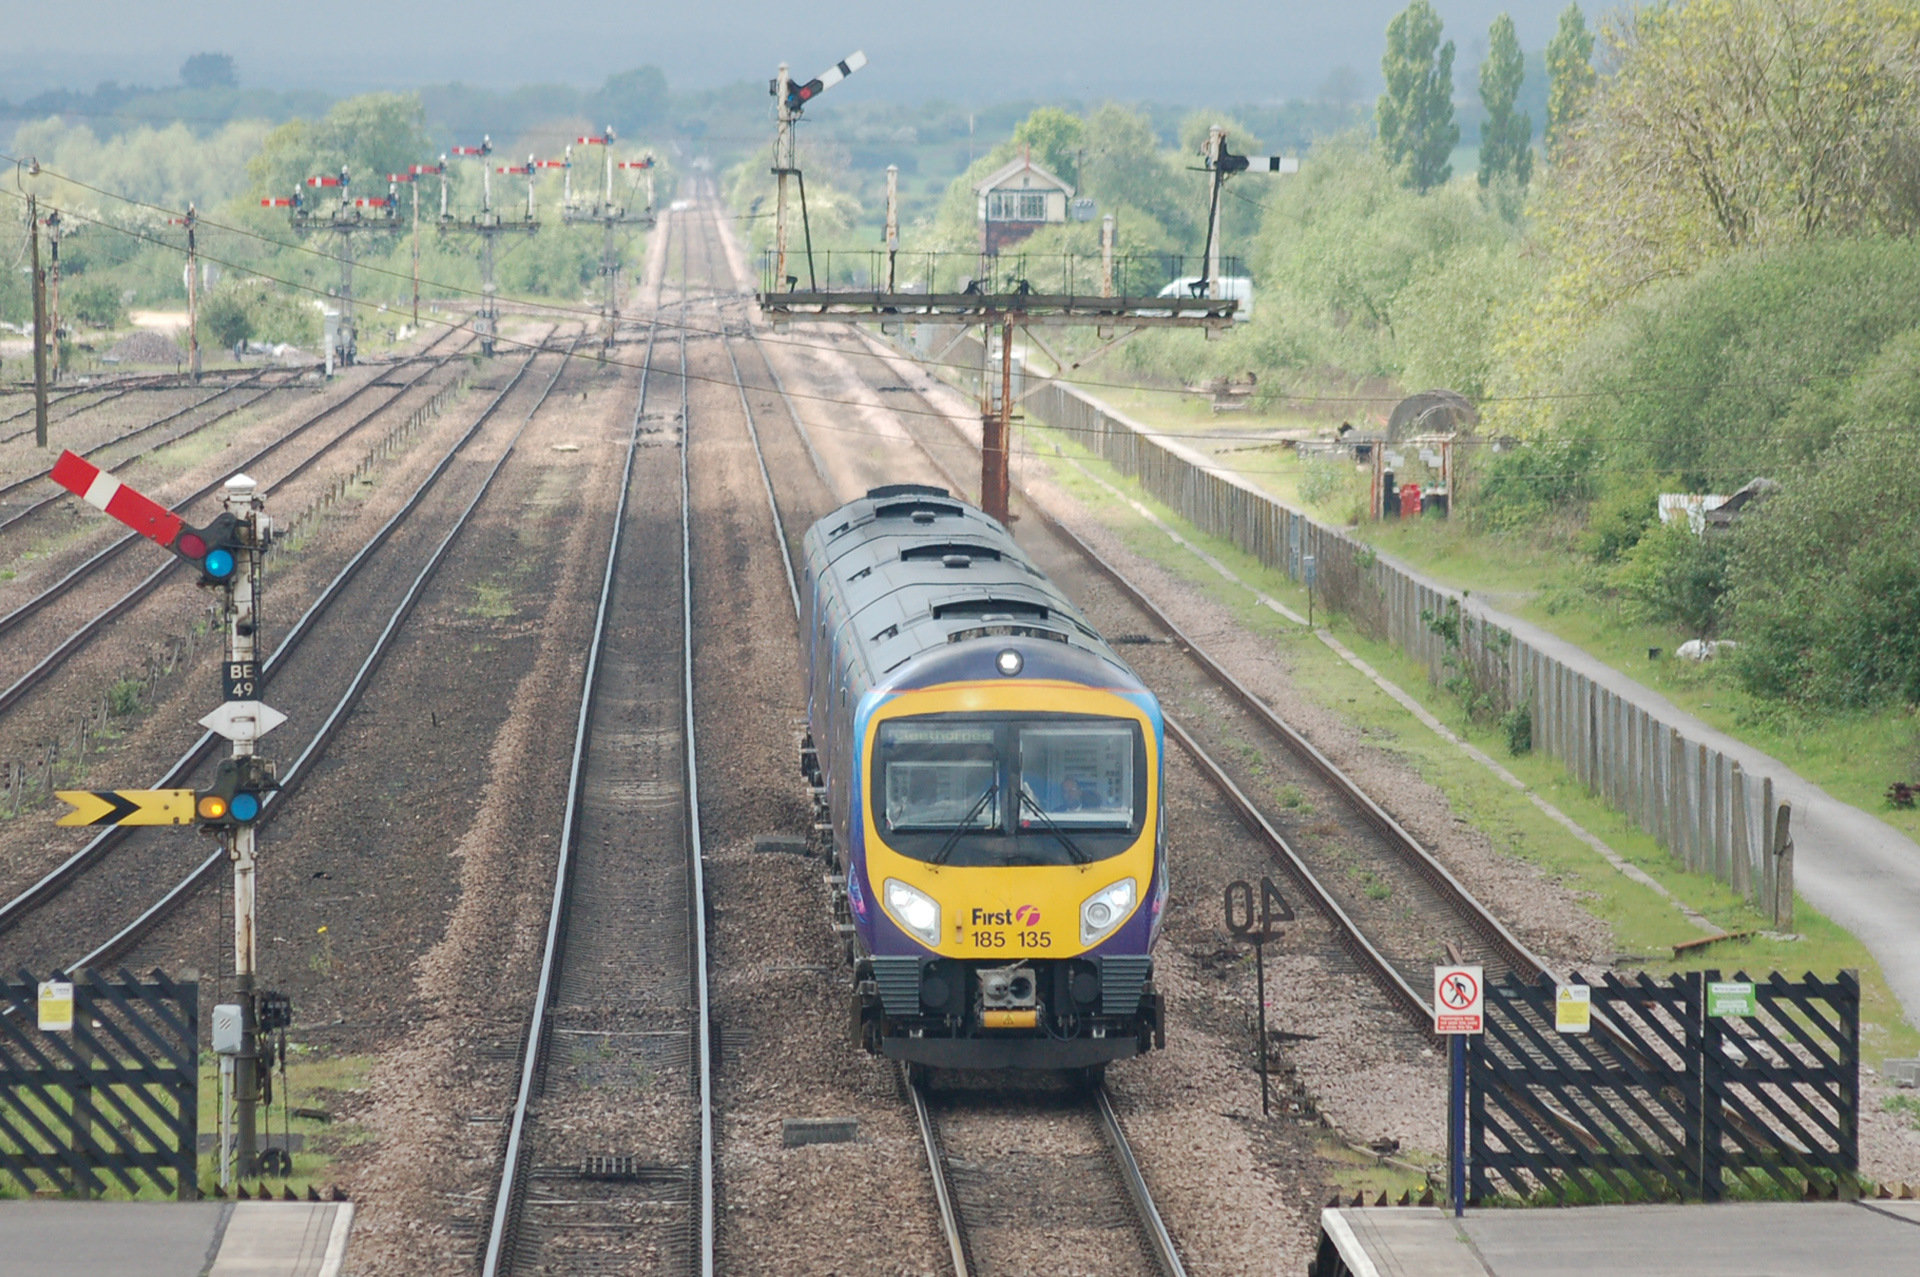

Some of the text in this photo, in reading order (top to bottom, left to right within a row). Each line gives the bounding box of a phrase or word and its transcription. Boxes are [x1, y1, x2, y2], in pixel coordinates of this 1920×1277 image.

[230, 664, 254, 679] BE
[232, 682, 254, 697] 49
[972, 908, 1012, 926] First
[971, 931, 1052, 948] 185 135
